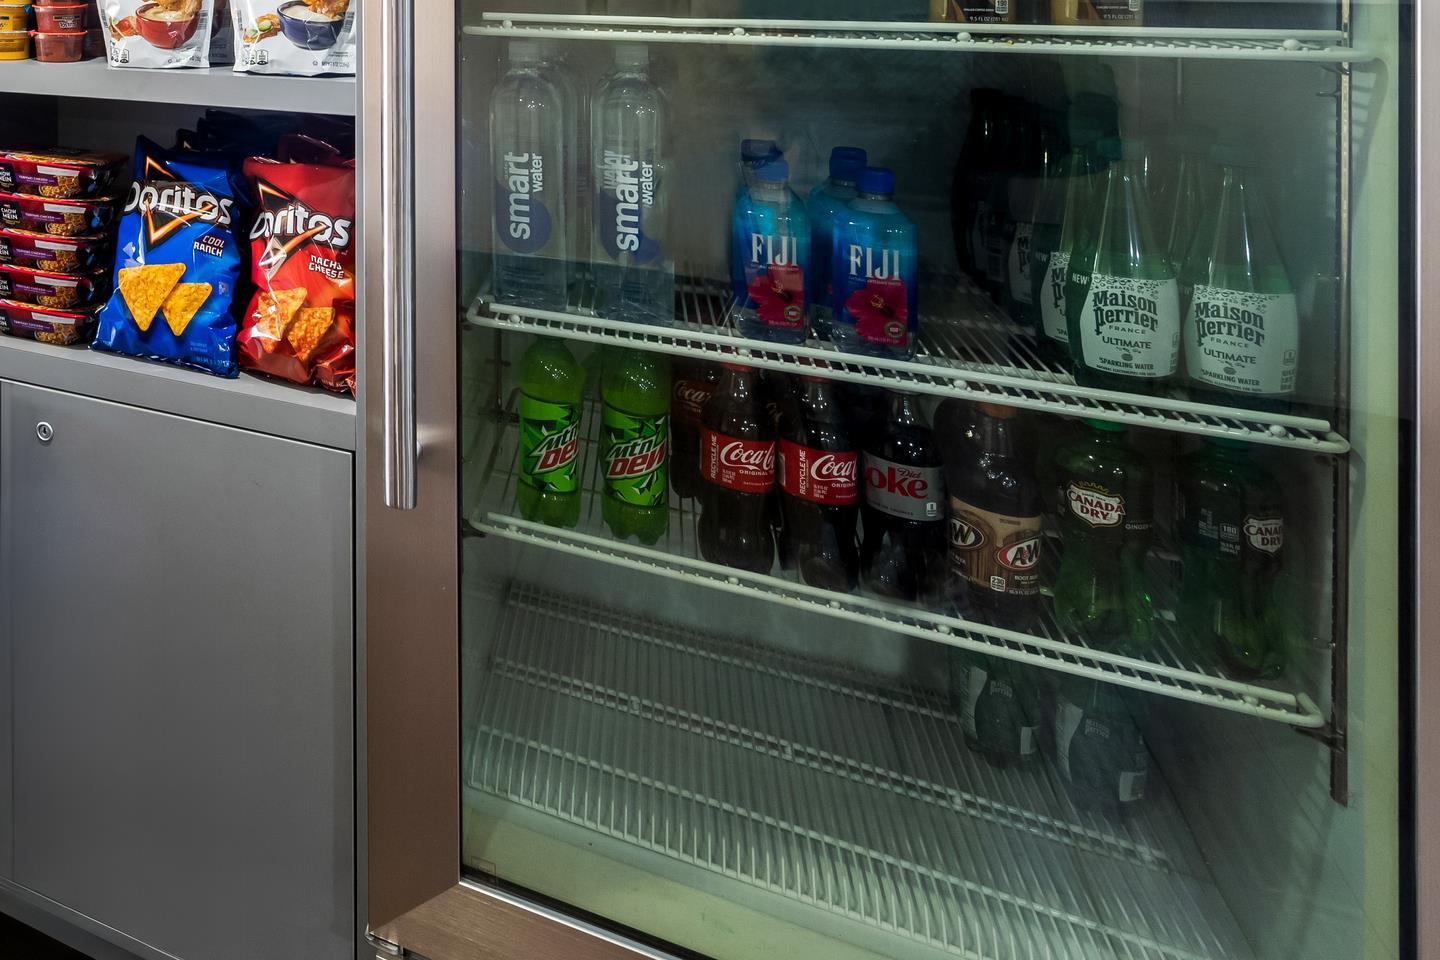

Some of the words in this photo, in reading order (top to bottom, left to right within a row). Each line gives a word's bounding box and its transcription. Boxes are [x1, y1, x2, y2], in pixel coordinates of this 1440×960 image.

[530, 152, 543, 193] water
[638, 161, 653, 205] water
[124, 180, 234, 226] Doritos
[504, 151, 531, 240] smart
[616, 160, 639, 252] smart
[249, 204, 352, 247] Doritos
[193, 241, 223, 258] RANCH
[202, 235, 225, 248] COOL
[751, 232, 798, 266] FIJI
[309, 262, 345, 279] CHEESE
[849, 244, 901, 282] FIJI
[1092, 289, 1158, 316] Maison
[1194, 301, 1265, 330] Maison
[1109, 325, 1146, 335] FRANCE
[1210, 336, 1249, 348] FRANCE
[1102, 335, 1152, 350] ULTIMATE
[1134, 362, 1154, 370] WATER
[1203, 347, 1257, 364] ULTIMATE
[1237, 378, 1260, 386] WATER
[537, 439, 578, 470] De
[609, 438, 653, 459] Mtn
[720, 441, 775, 470] Coca-C
[799, 449, 806, 461] ME
[865, 466, 928, 500] oke
[1067, 490, 1126, 514] CANADA
[1080, 505, 1110, 521] DRY
[1243, 523, 1281, 537] CANA
